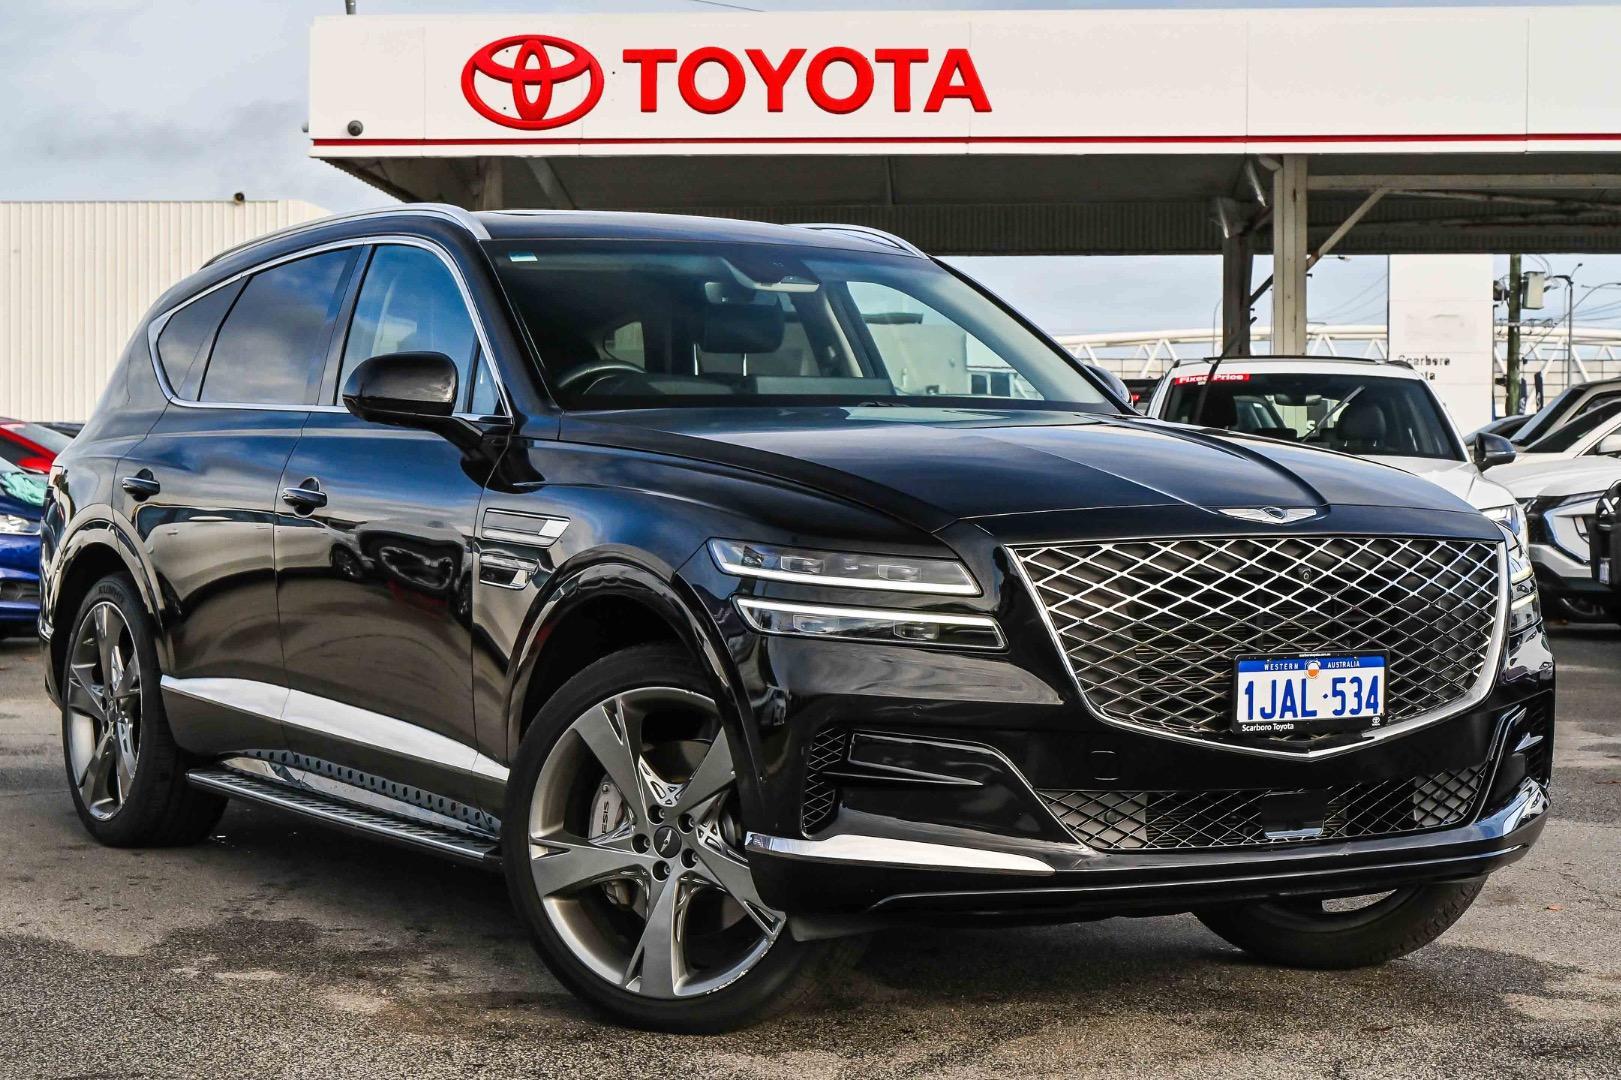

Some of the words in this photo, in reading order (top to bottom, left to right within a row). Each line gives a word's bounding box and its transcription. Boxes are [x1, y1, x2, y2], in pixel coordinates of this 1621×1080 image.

[622, 46, 992, 114] TOYOTA
[1264, 663, 1298, 671] WESTERN
[1327, 660, 1360, 668] AUSTRALIA
[1273, 723, 1294, 731] Toyota
[601, 801, 609, 834] ESIS
